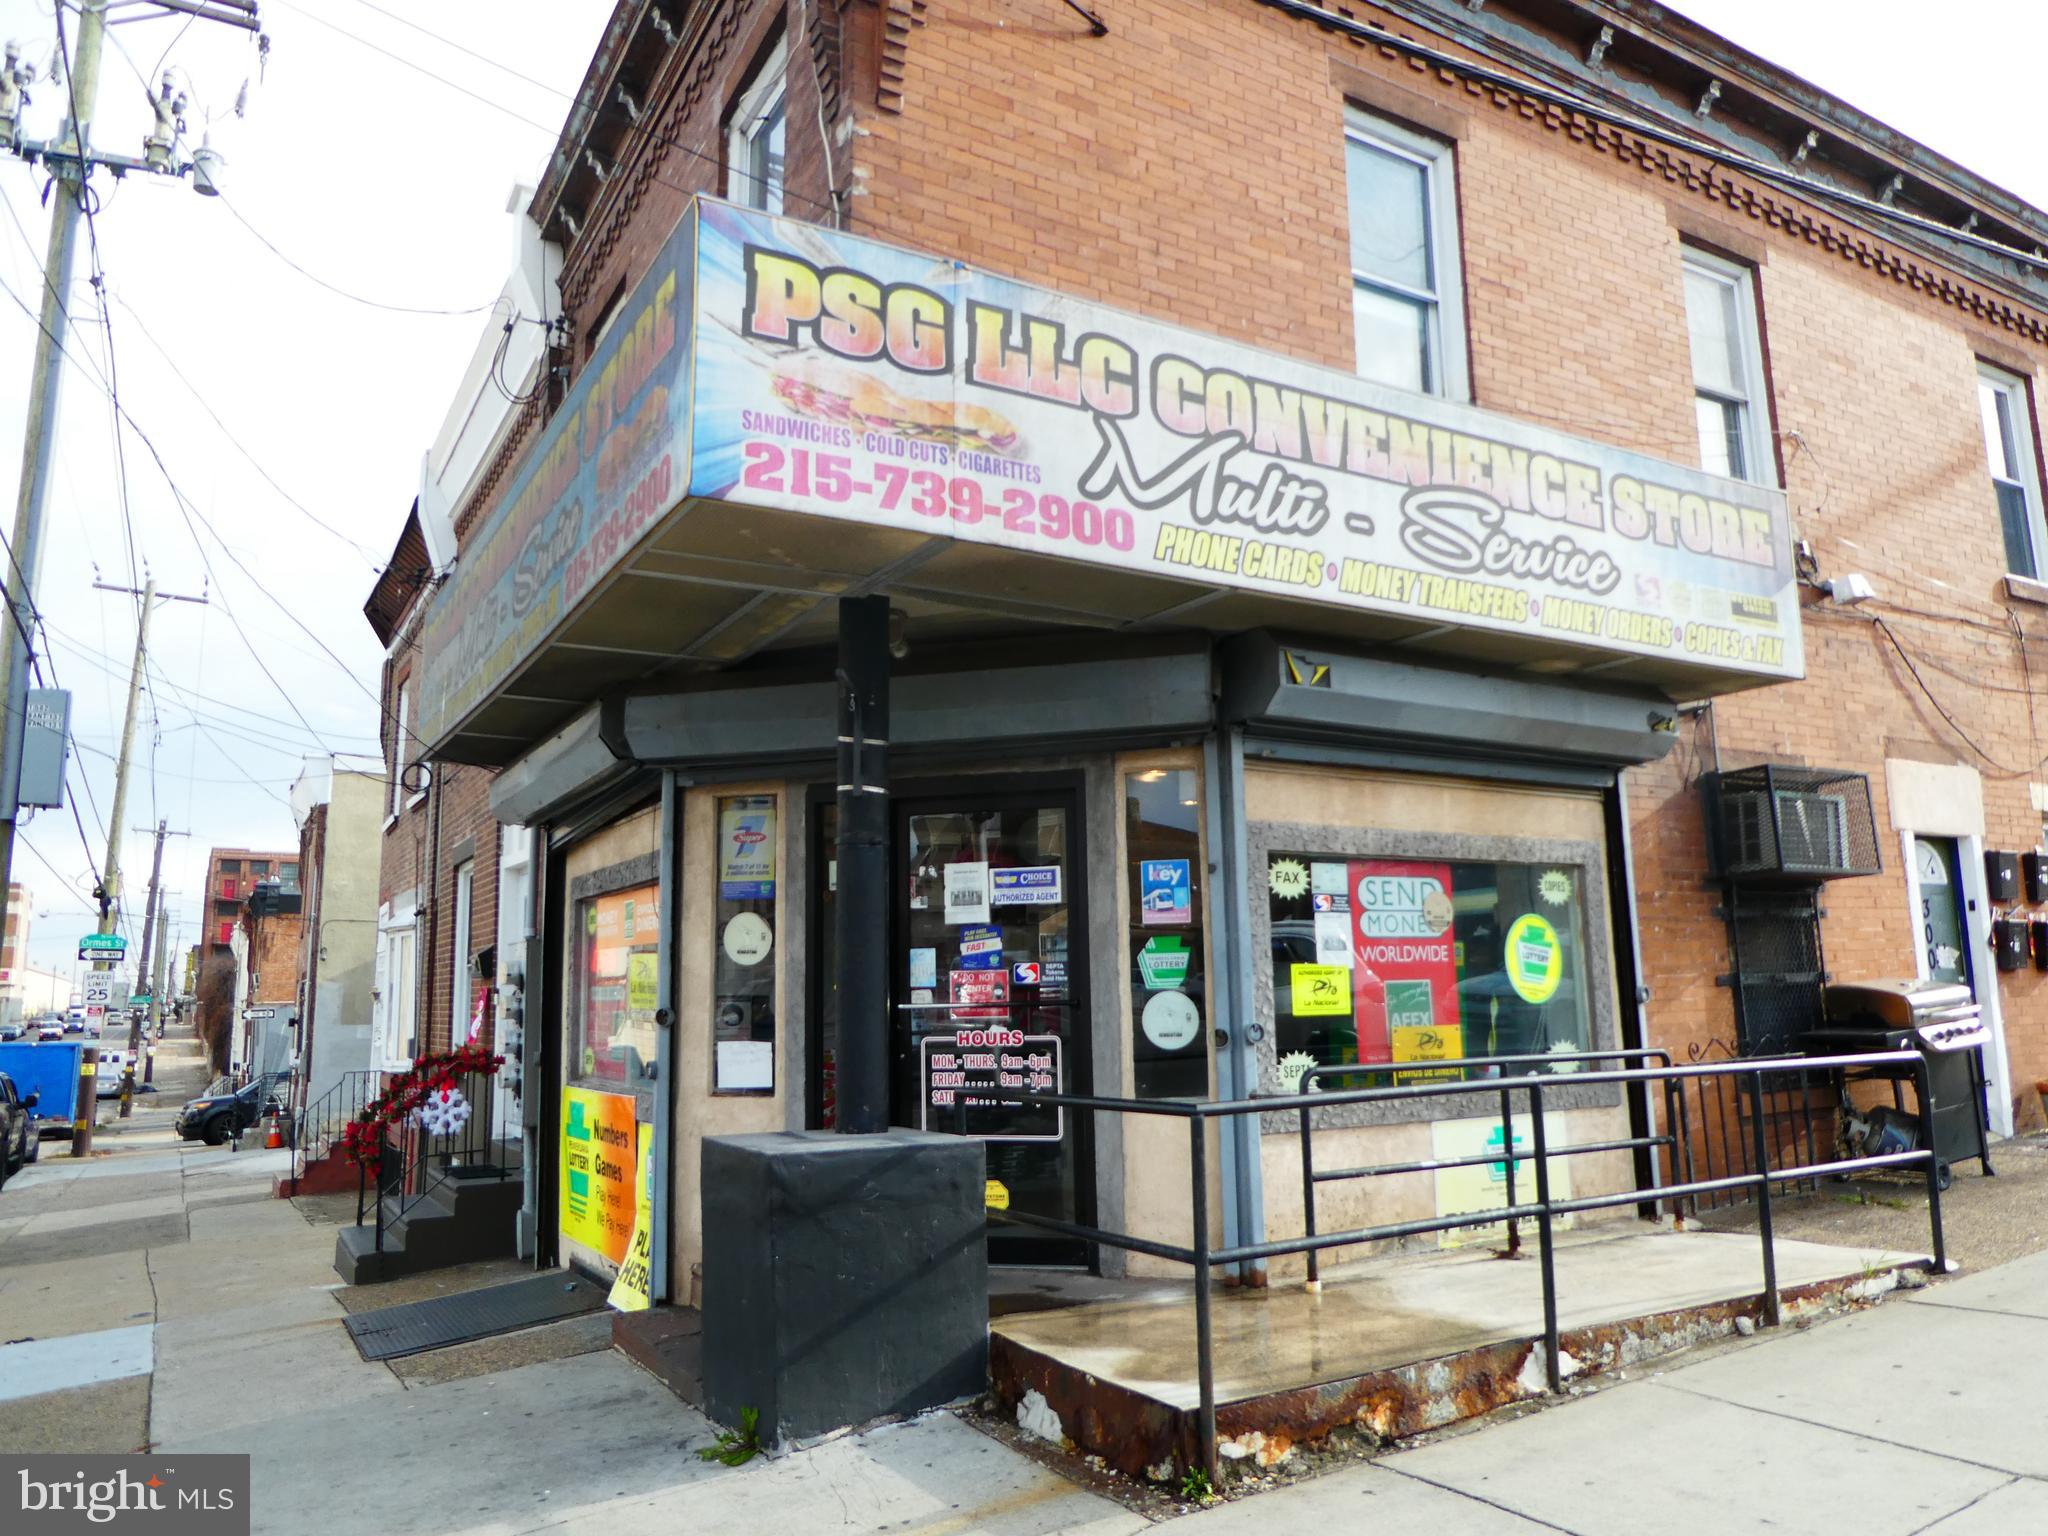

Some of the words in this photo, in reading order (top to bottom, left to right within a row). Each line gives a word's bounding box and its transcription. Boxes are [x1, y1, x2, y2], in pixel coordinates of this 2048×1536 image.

[582, 269, 677, 457] STORE
[741, 242, 954, 377] PSG
[965, 297, 1139, 421] LLC
[1150, 353, 1606, 535] CONVENIENCE
[1610, 473, 1777, 570] STORE
[741, 410, 852, 448] SANDWICHES
[866, 433, 908, 460] COLD
[909, 439, 949, 467] CUTS
[958, 448, 1042, 484] CIGARETTES
[743, 441, 1136, 552] 215-739-2900
[1078, 412, 1330, 538] Multi
[1399, 485, 1621, 596] Service
[563, 454, 673, 604] 215-739-2900
[1154, 522, 1240, 575] PHONE
[1241, 539, 1325, 589] CARDS
[1339, 557, 1418, 611] MONEY
[1416, 573, 1529, 624] TRANSFERS
[1541, 593, 1607, 638] MONEY
[1604, 607, 1672, 649] ORDERS
[1684, 621, 1742, 660] COPIES
[1742, 635, 1757, 661] &
[1755, 633, 1784, 667] FAX
[1020, 872, 1052, 884] CHOICE
[1149, 864, 1182, 886] key
[1275, 871, 1300, 885] FAX
[993, 891, 1035, 902] AUTHORIZED
[1036, 892, 1058, 901] AGENT
[1366, 879, 1437, 907] SEND
[1367, 914, 1430, 933] MONE
[966, 942, 985, 953] FAST
[1360, 945, 1449, 963] WORLDWIDE
[963, 973, 974, 982] DO
[979, 973, 995, 982] NOT
[86, 988, 108, 1001] 25
[957, 1030, 1024, 1047] HOURS
[1283, 1065, 1310, 1078] SEPT
[593, 1118, 628, 1150] Numbers
[595, 1152, 623, 1184] Games
[596, 1186, 607, 1205] Play
[605, 1214, 615, 1236] Pay
